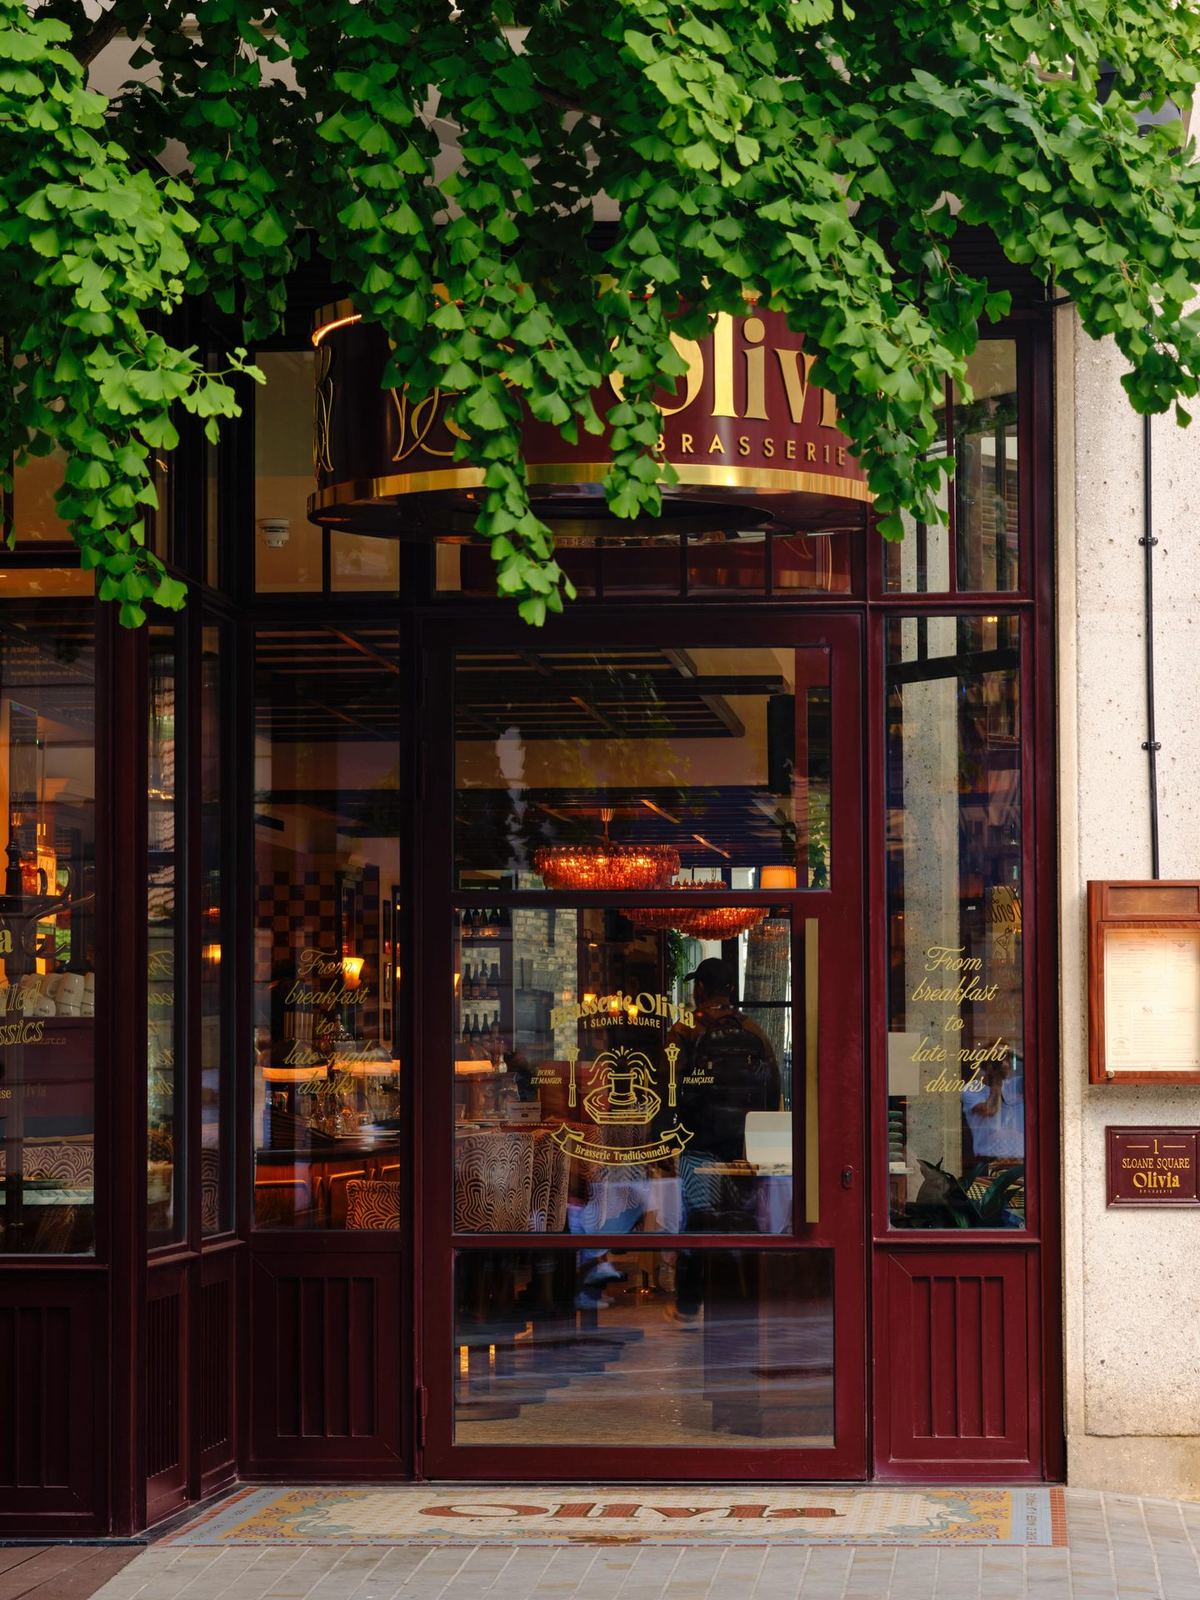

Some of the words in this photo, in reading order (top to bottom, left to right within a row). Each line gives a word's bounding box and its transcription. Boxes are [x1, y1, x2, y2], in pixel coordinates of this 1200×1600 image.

[608, 311, 838, 429] Oliv
[654, 433, 847, 466] BRASSERIE
[297, 949, 355, 976] From
[924, 946, 983, 972] From
[284, 978, 371, 1011] breakfast
[912, 975, 999, 1006] breakfast
[591, 1016, 624, 1028] SLOANE
[627, 1016, 661, 1029] SQUARE
[635, 992, 697, 1029] Olivia
[943, 1014, 965, 1032] to
[315, 1017, 336, 1035] to
[911, 1036, 1010, 1069] late-night
[924, 1067, 986, 1093] drinks
[574, 1143, 612, 1160] Brasserie
[613, 1145, 672, 1161] Traditionnelle
[1153, 1139, 1159, 1154] 1
[1121, 1158, 1154, 1169] SLOANE
[1156, 1158, 1190, 1170] SQUARE
[1133, 1171, 1181, 1188] Olivia
[418, 1502, 848, 1518] Olivia
